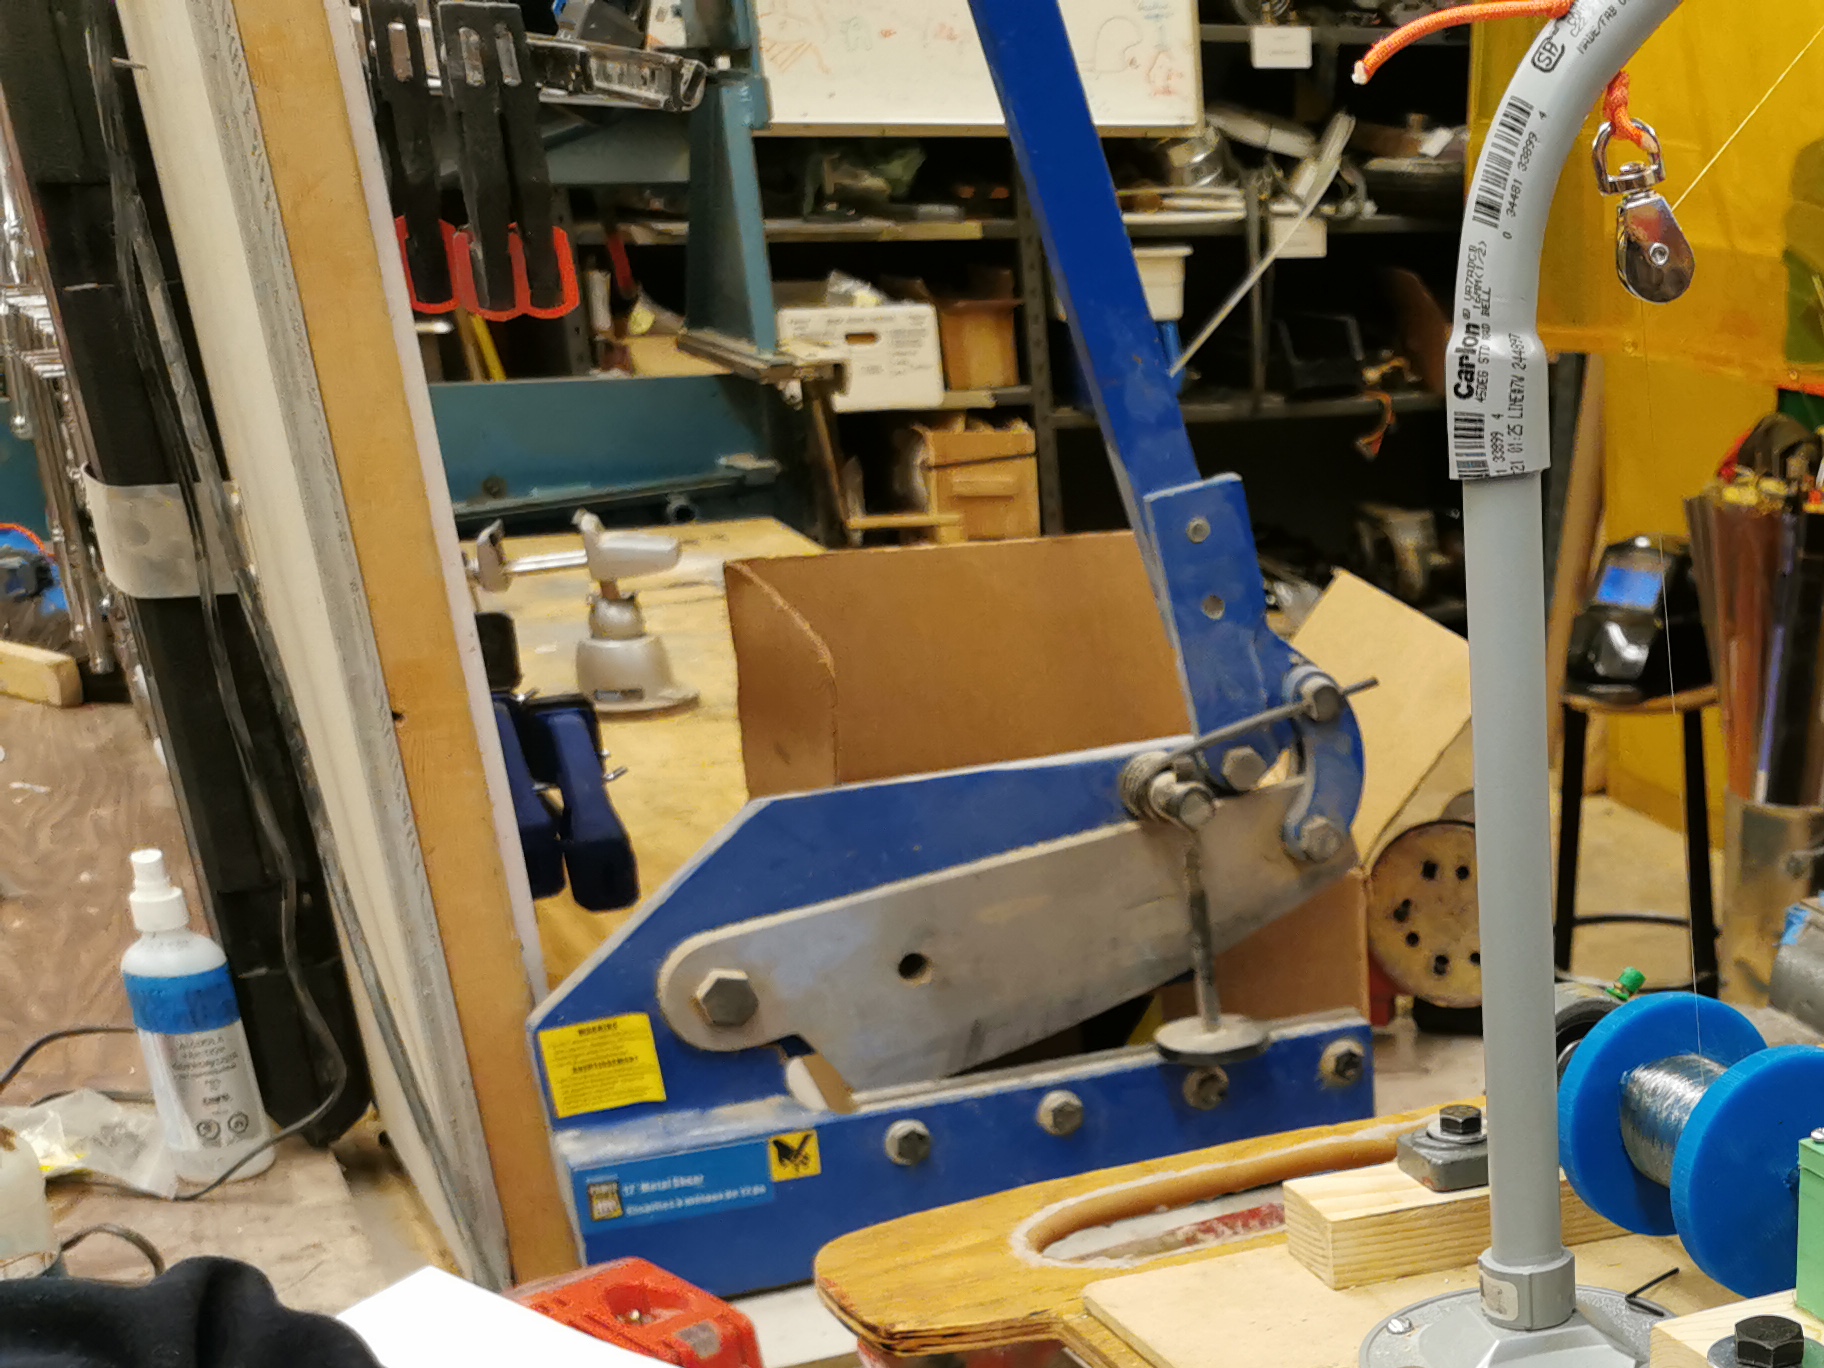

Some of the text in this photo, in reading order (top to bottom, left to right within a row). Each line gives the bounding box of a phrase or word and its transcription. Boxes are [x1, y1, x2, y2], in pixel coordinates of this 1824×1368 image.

[1502, 111, 1547, 240] 0 34481 33899 4
[1481, 287, 1491, 318] BELL
[1453, 322, 1480, 400] Carlon
